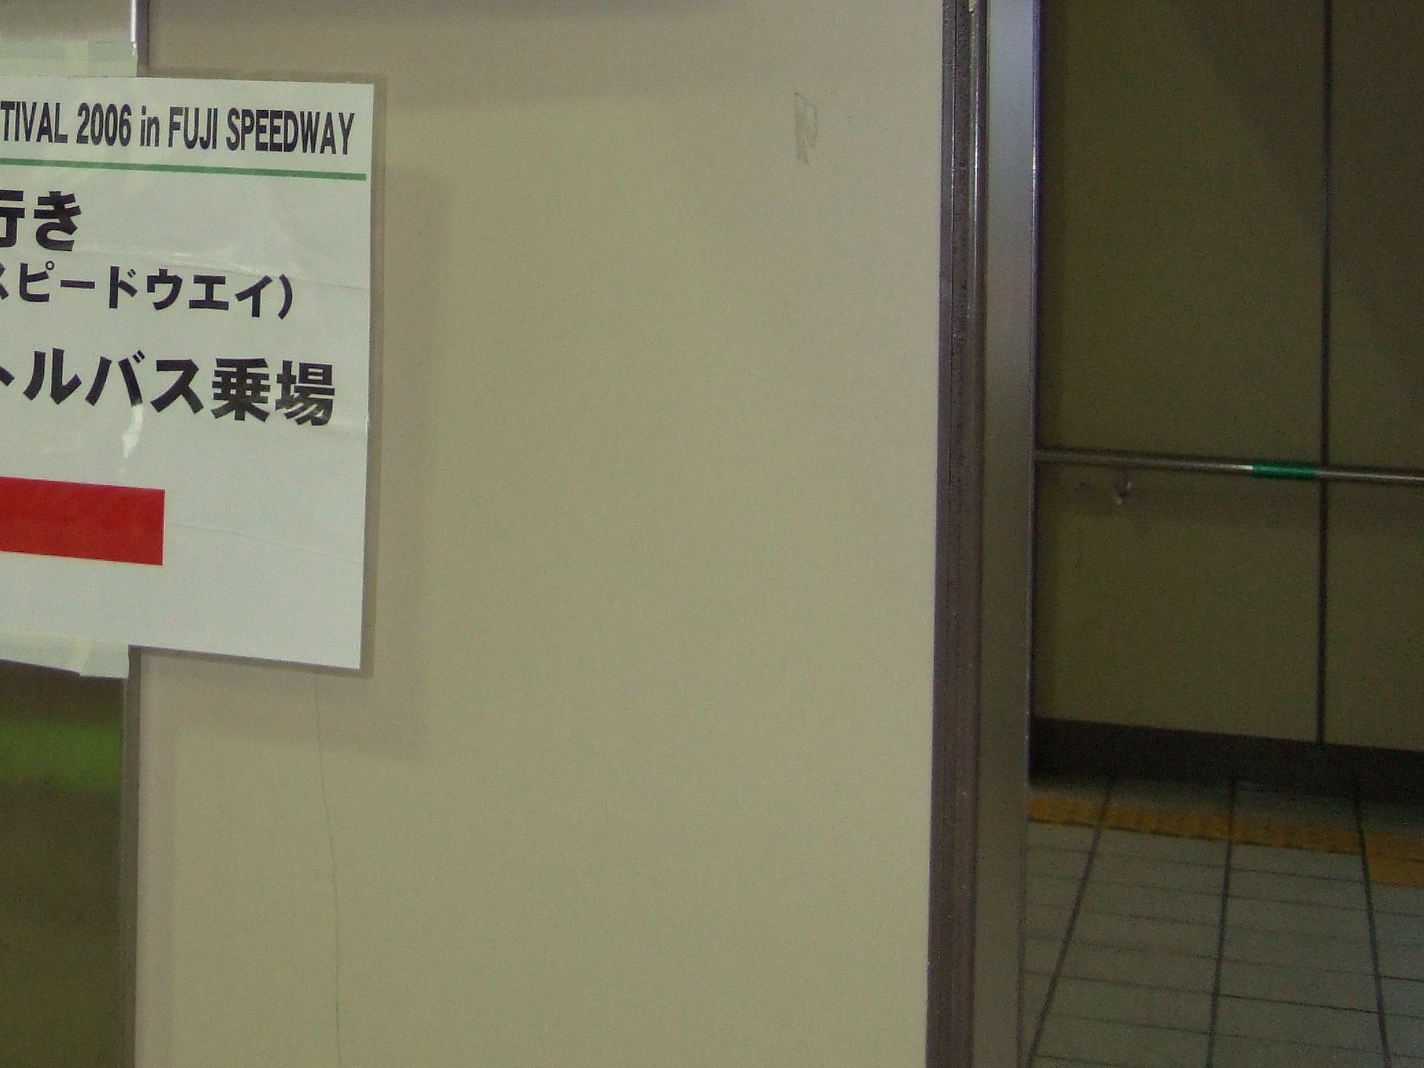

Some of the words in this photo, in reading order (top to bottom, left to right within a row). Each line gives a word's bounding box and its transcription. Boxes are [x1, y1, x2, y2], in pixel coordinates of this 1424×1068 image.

[77, 104, 132, 146] 2006
[140, 106, 160, 147] in
[169, 108, 218, 150] FUJI
[227, 109, 355, 155] SPEEDWAY
